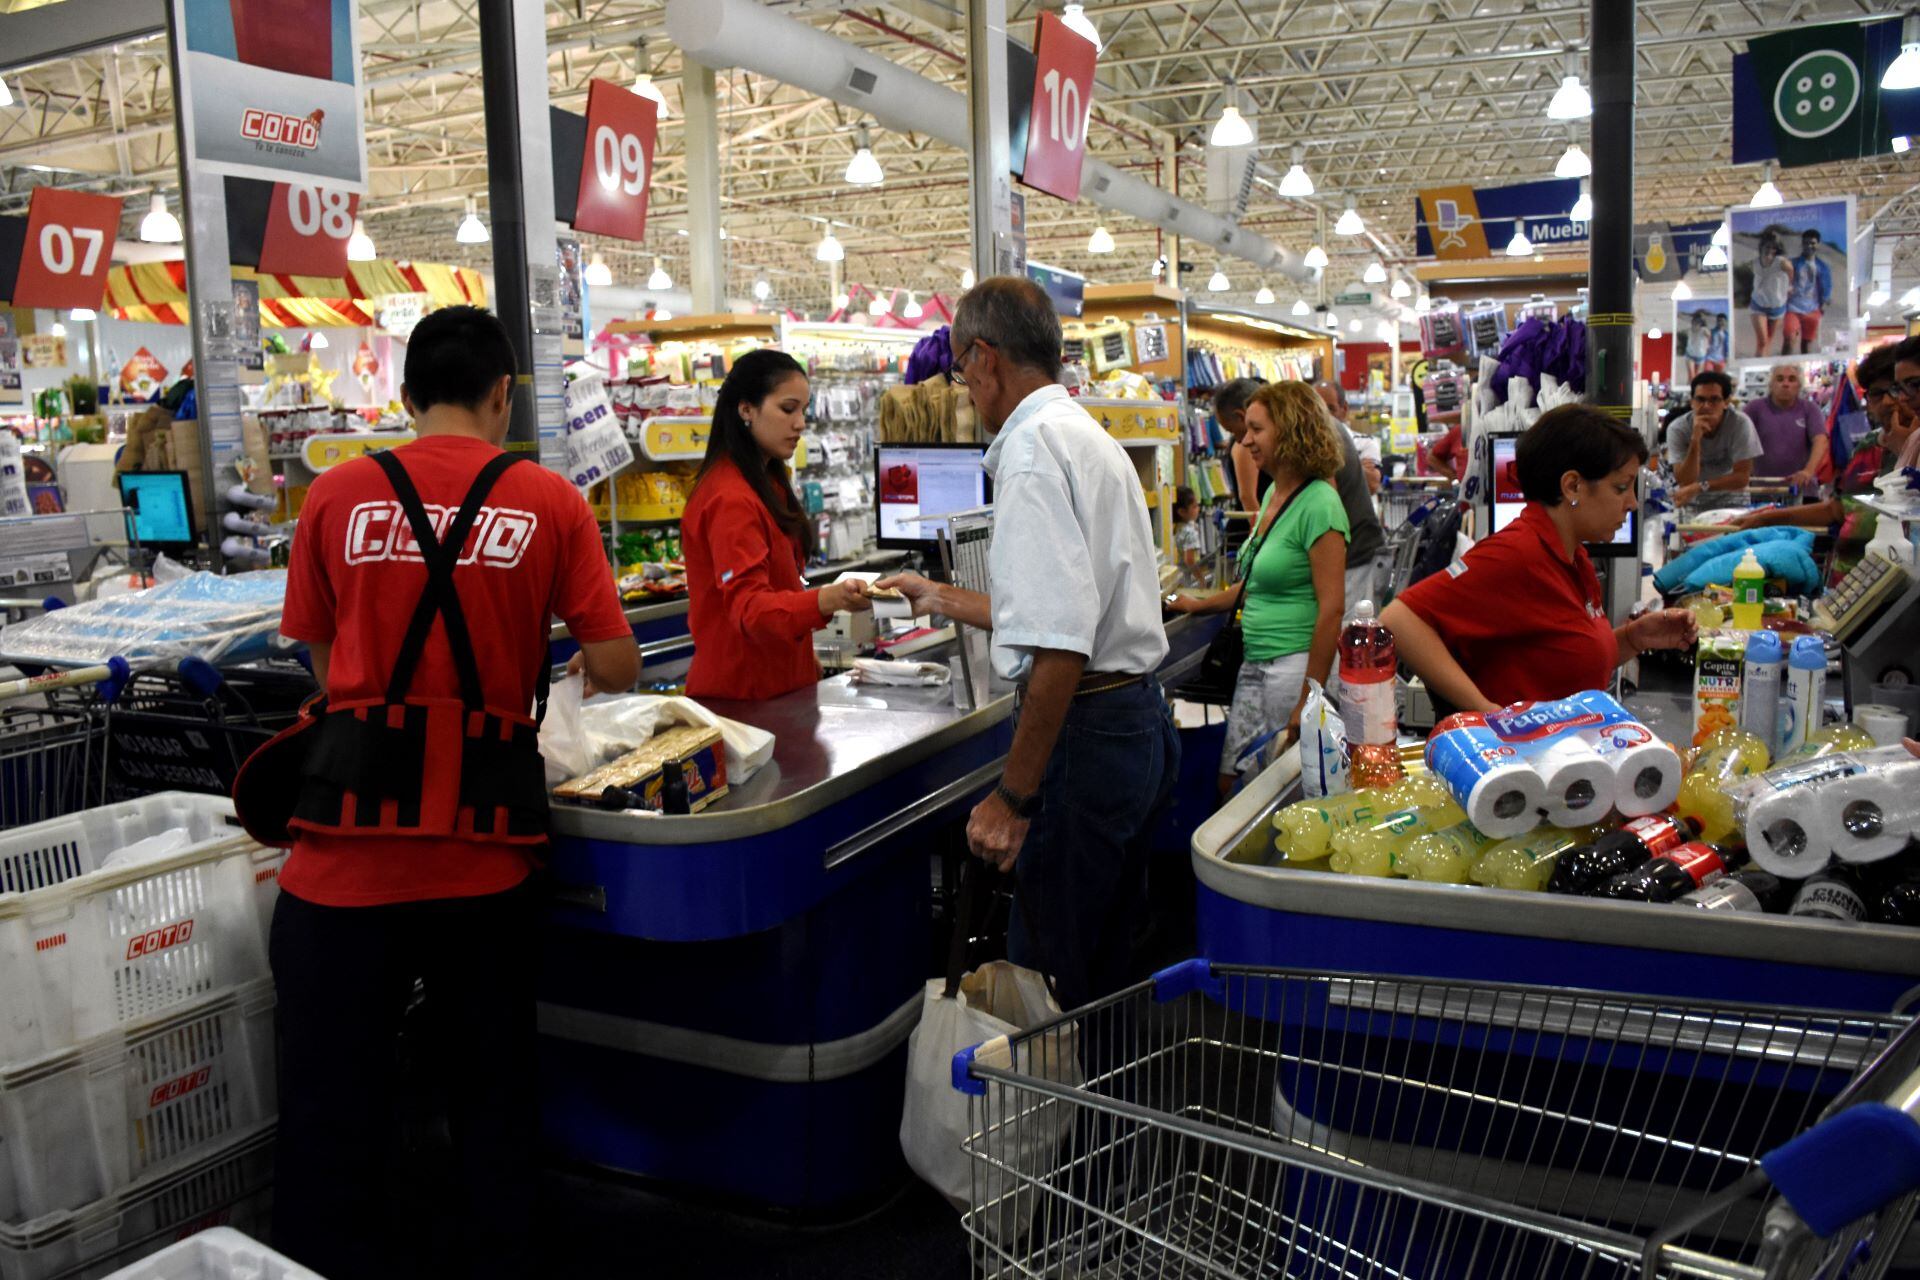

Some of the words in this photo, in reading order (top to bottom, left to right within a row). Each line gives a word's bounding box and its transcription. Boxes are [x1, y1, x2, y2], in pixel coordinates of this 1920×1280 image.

[241, 108, 320, 149] COTO
[1043, 68, 1080, 151] 10
[595, 125, 646, 196] 09
[287, 183, 352, 239] 08
[40, 223, 104, 277] 07
[1699, 675, 1739, 687] NUTRI
[114, 730, 141, 753] NO
[133, 735, 189, 757] PASAR
[119, 758, 159, 780] CAJA
[153, 763, 225, 790] CERRADA
[127, 919, 194, 961] COTO
[149, 1065, 212, 1109] COTO
